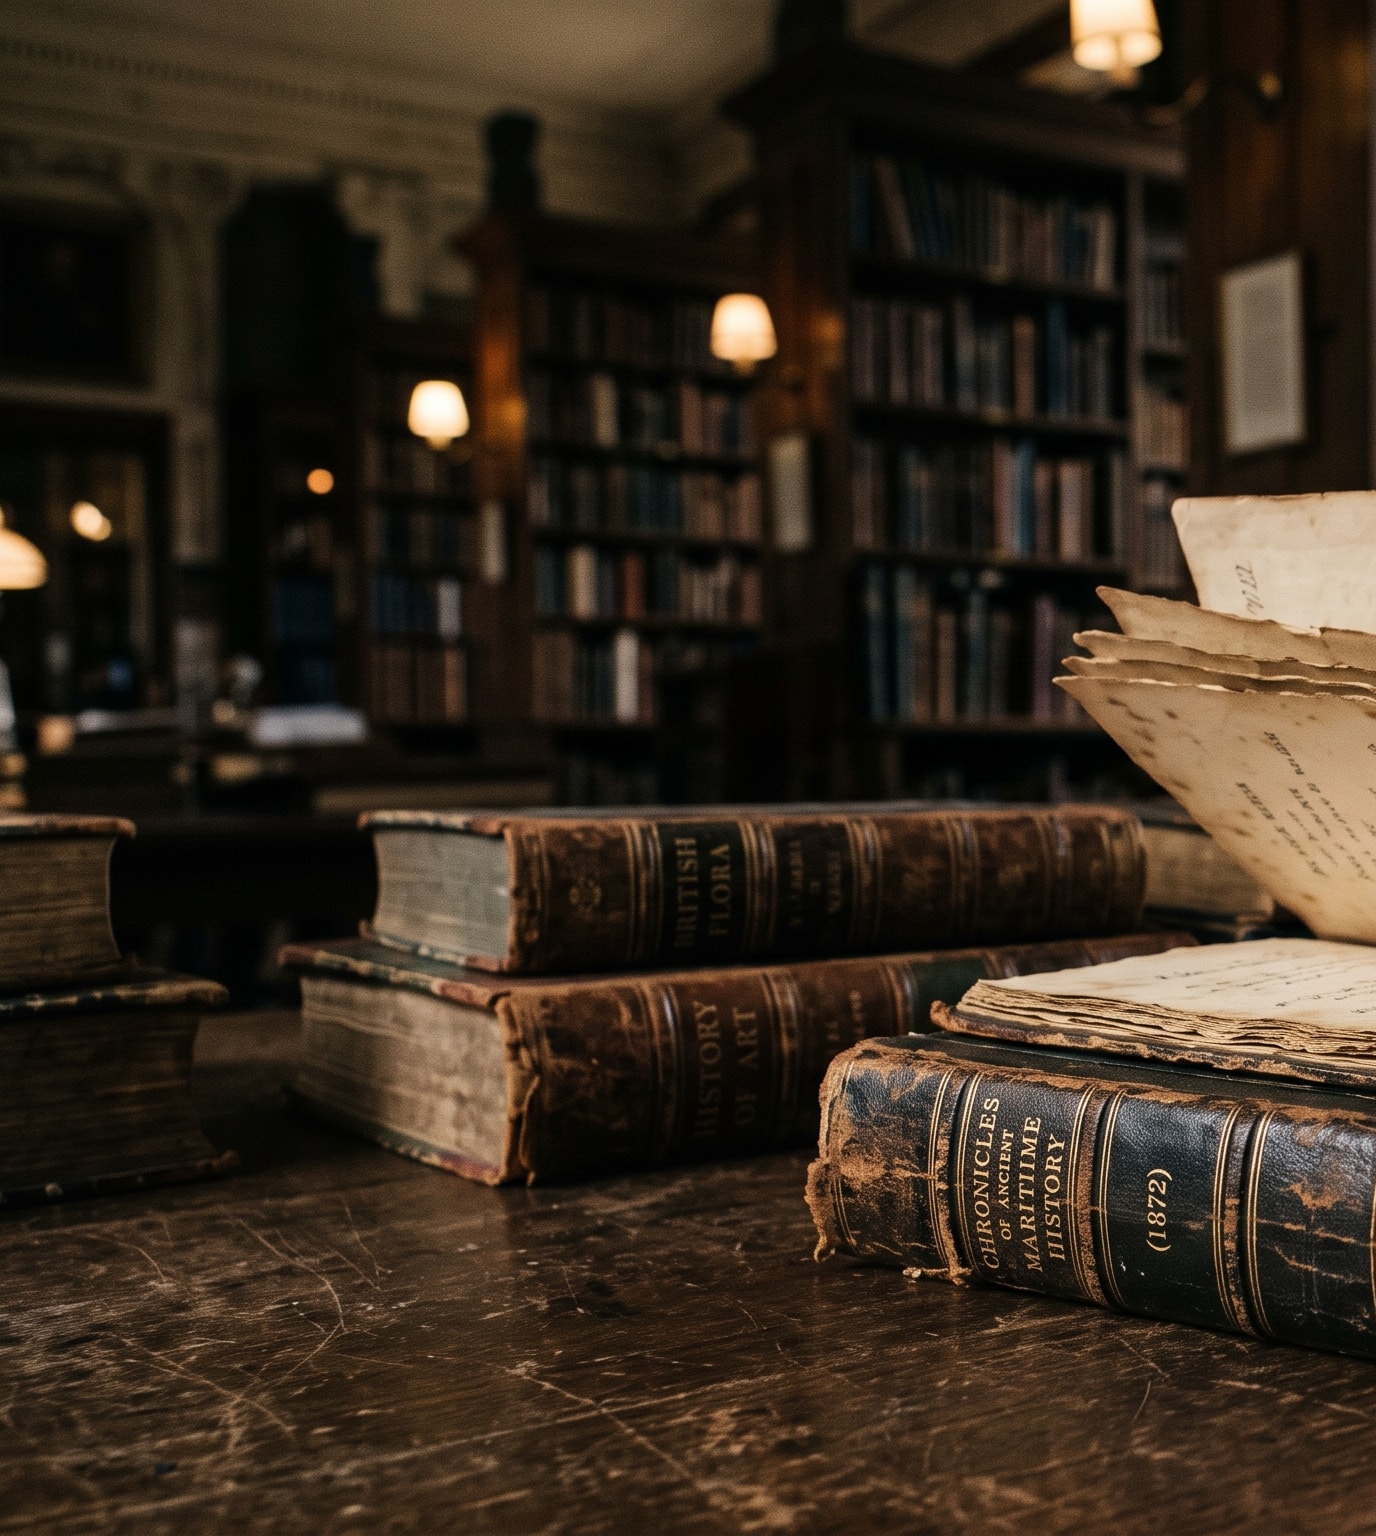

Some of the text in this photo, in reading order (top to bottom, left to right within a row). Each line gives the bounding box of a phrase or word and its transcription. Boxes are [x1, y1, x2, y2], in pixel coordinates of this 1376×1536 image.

[674, 836, 697, 949] BRITISH
[708, 842, 731, 938] FLORA
[693, 999, 722, 1137] HISTORY
[732, 1006, 759, 1126] OF ART
[972, 1098, 1000, 1269] CHRONICLES
[998, 1128, 1015, 1241] OF ANCIENT
[1146, 1168, 1173, 1252] (1872)
